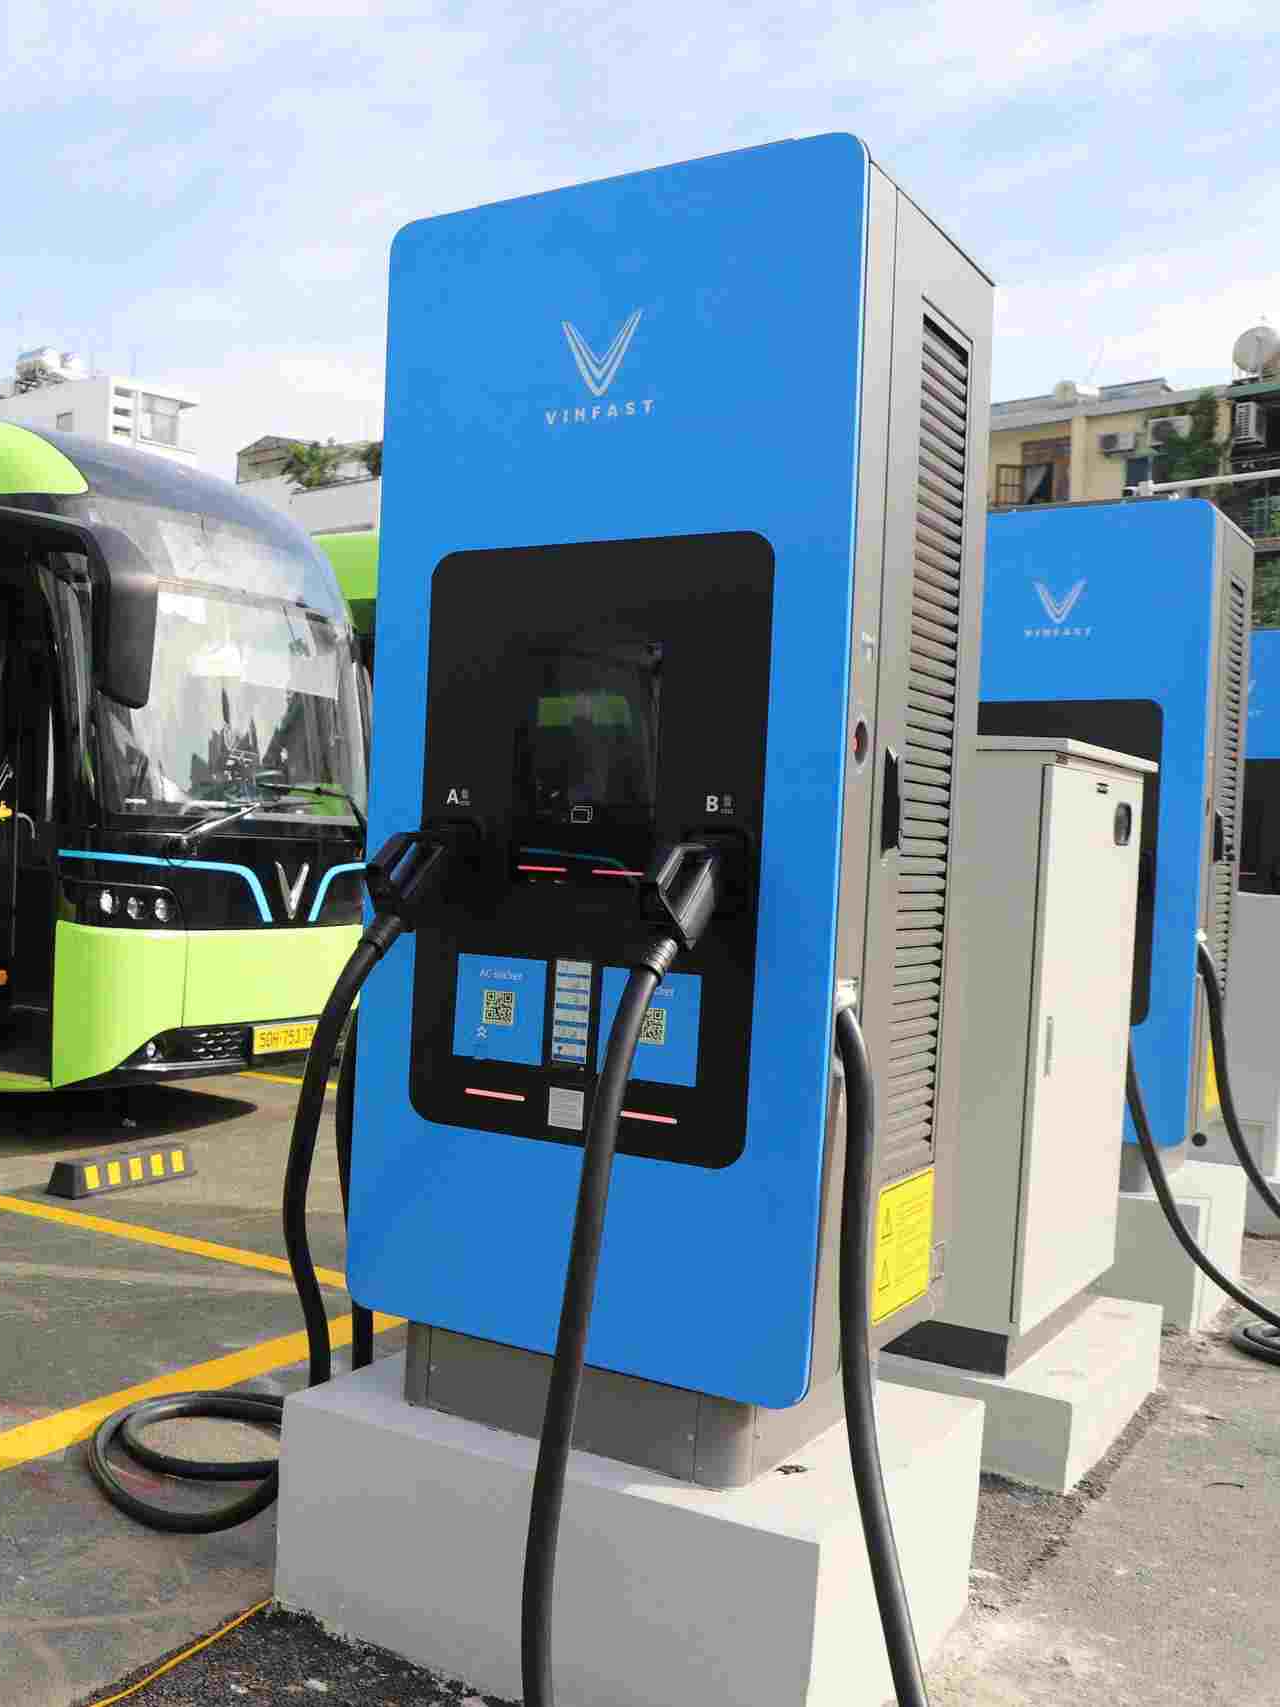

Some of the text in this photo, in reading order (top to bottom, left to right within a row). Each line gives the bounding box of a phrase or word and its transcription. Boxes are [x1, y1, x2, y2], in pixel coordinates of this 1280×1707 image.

[545, 400, 655, 424] VINFAST
[447, 788, 458, 804] A
[706, 795, 719, 812] B
